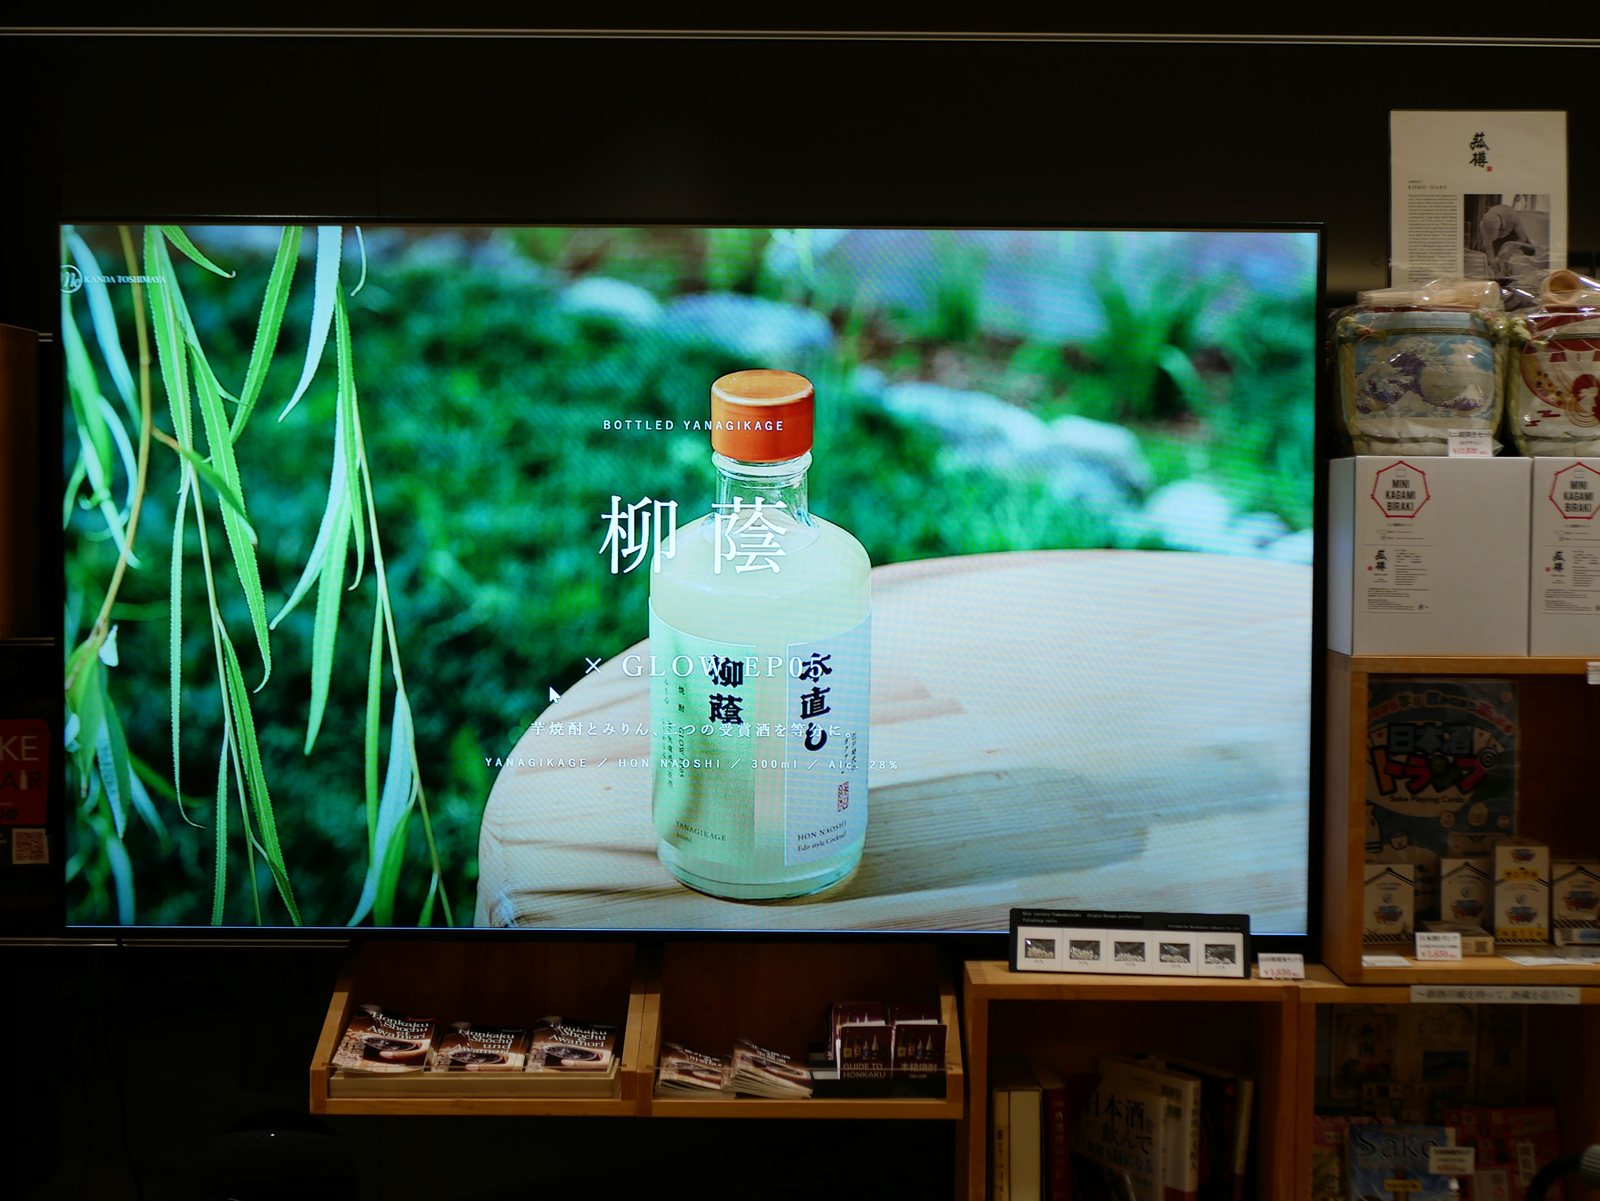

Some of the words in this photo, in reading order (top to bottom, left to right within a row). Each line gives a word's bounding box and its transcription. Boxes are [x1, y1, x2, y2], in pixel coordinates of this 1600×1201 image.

[85, 275, 116, 283] KANDA
[117, 275, 167, 284] TOSHIMAYA
[603, 420, 674, 431] BOTTLED
[684, 420, 784, 431] YANAGIKAGE
[1392, 479, 1410, 489] MINI
[1570, 480, 1588, 490] MINI
[1385, 490, 1417, 500] KAGAMI
[1563, 491, 1595, 501] KAGAMI
[1387, 502, 1415, 511] BIRAKI
[1565, 503, 1592, 512] BIRAKI
[622, 654, 728, 678] GLOW
[744, 654, 826, 679] EP05
[1389, 724, 1473, 754] 日本酒
[485, 756, 588, 769] YANAGIKAGE
[618, 757, 650, 769] HON
[660, 757, 722, 770] NAOSHI
[750, 758, 799, 771] 300ml
[869, 760, 899, 771] 28%
[1371, 746, 1498, 796] トランプ
[675, 820, 728, 842] YANAGIKAGE
[797, 831, 818, 842] HON
[818, 819, 848, 837] NAOSHI
[369, 1011, 430, 1029] Honkaku
[367, 1025, 426, 1040] Awamori
[458, 1029, 516, 1040] Honkaku
[550, 1022, 608, 1036] Honkaku
[548, 1034, 605, 1048] Awamori
[482, 1043, 513, 1051] und
[843, 1062, 870, 1071] GUIDE
[872, 1062, 884, 1071] TO
[842, 1071, 888, 1080] HONKAKU
